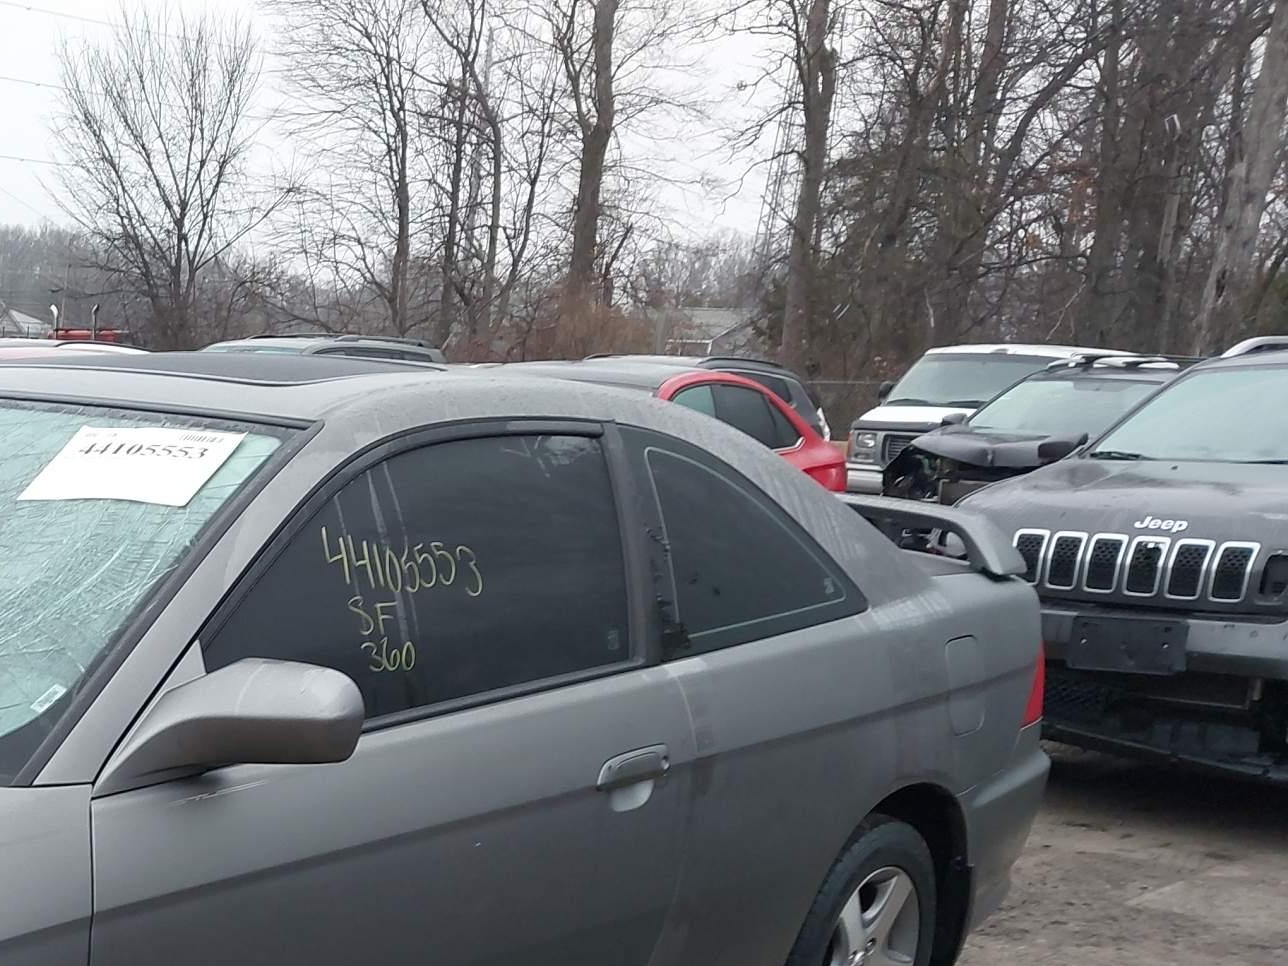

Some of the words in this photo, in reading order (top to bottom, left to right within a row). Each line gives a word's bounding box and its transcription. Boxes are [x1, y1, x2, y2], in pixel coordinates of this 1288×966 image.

[78, 441, 209, 459] 44105553
[1134, 516, 1188, 532] Jeep
[321, 526, 482, 596] 44105553
[360, 636, 416, 672] 360
